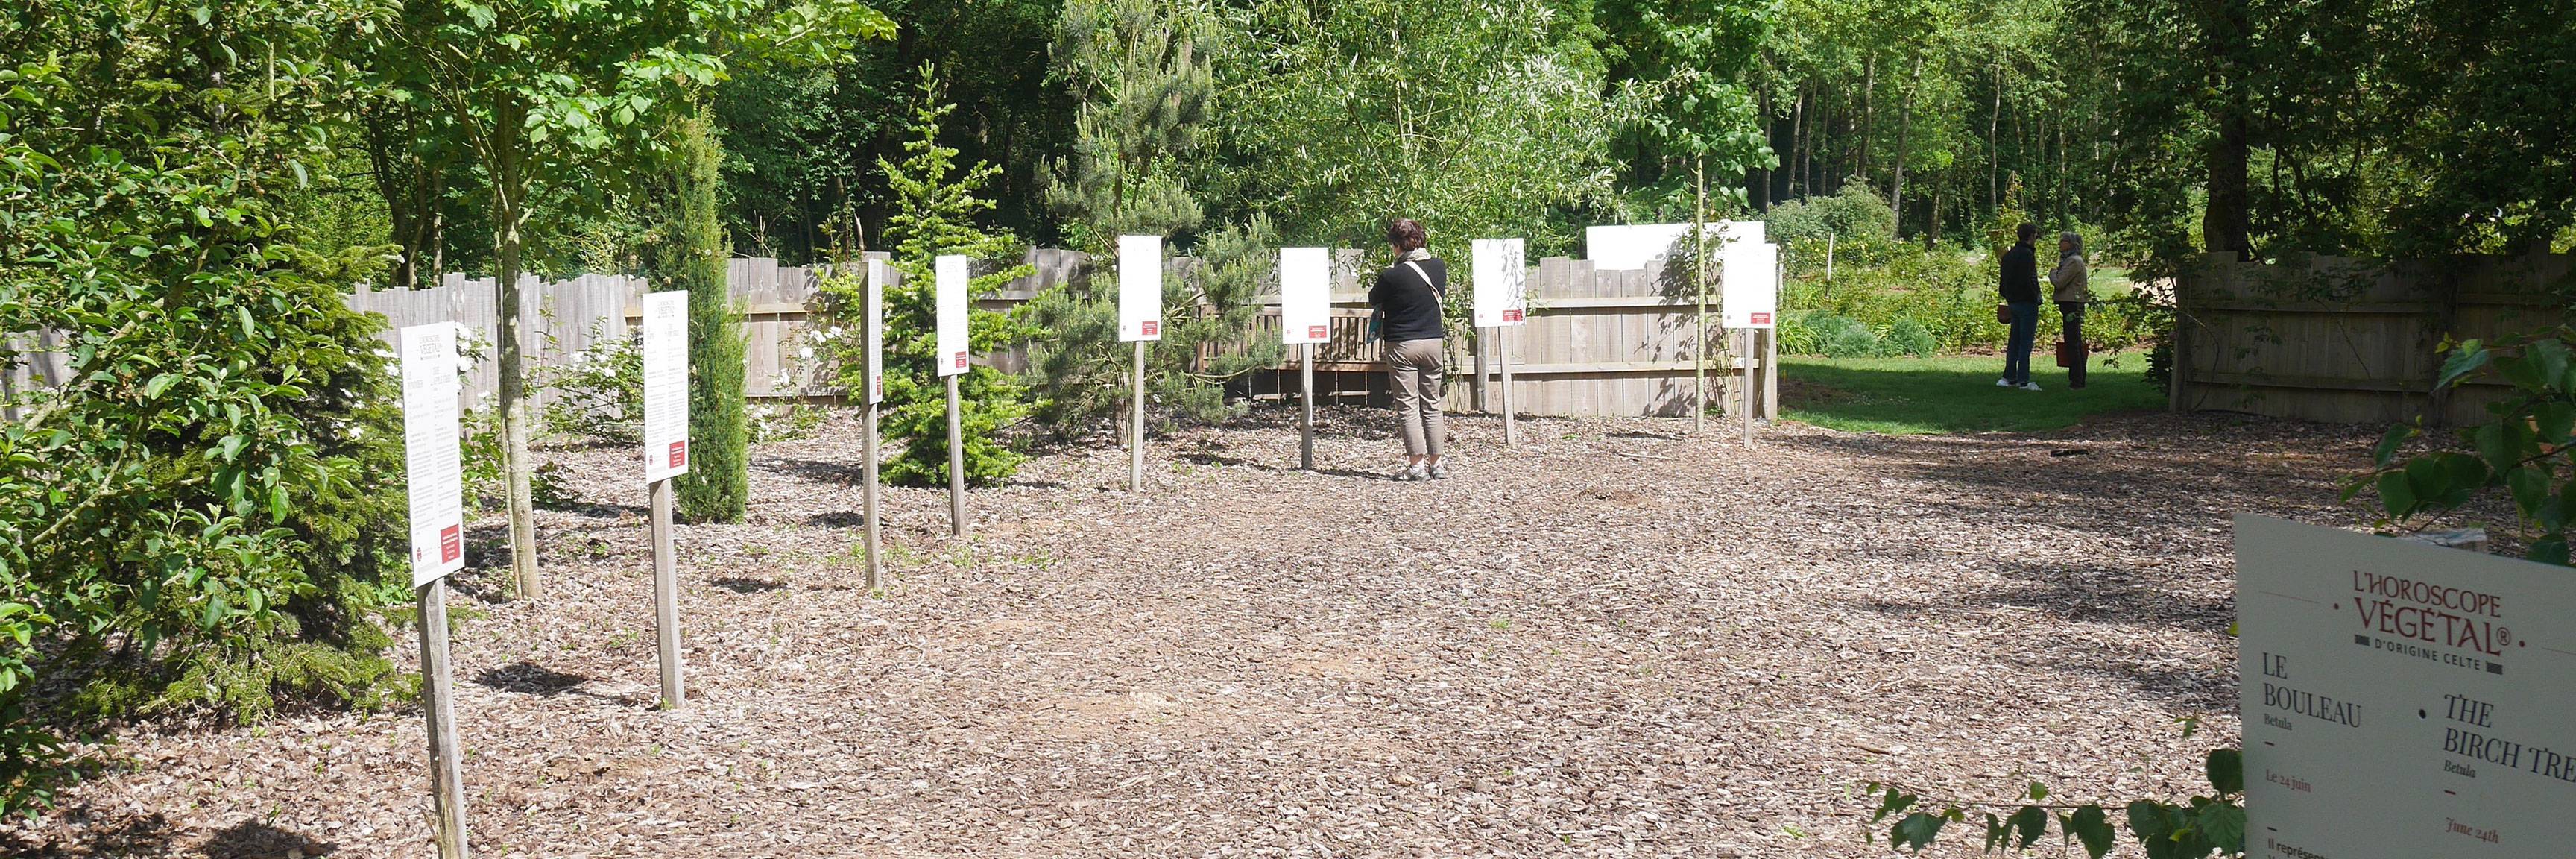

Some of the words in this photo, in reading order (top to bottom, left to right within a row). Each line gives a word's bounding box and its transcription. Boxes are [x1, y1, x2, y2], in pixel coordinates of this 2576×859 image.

[2353, 570, 2501, 618] L'HOROSCOPE
[2263, 652, 2288, 679] LE
[2375, 638, 2438, 661] D'ORIGINE
[2443, 652, 2481, 670] CELTE
[2263, 682, 2361, 728] BOULEAU
[2444, 694, 2494, 728] THE
[2264, 713, 2293, 731] Betula
[2443, 727, 2522, 769] BIRCH
[2266, 769, 2278, 783] Le
[2279, 775, 2290, 788] 24
[2291, 776, 2311, 793] juin
[2444, 759, 2476, 778] Betula
[2446, 817, 2473, 837] June
[2475, 829, 2499, 844] 24th
